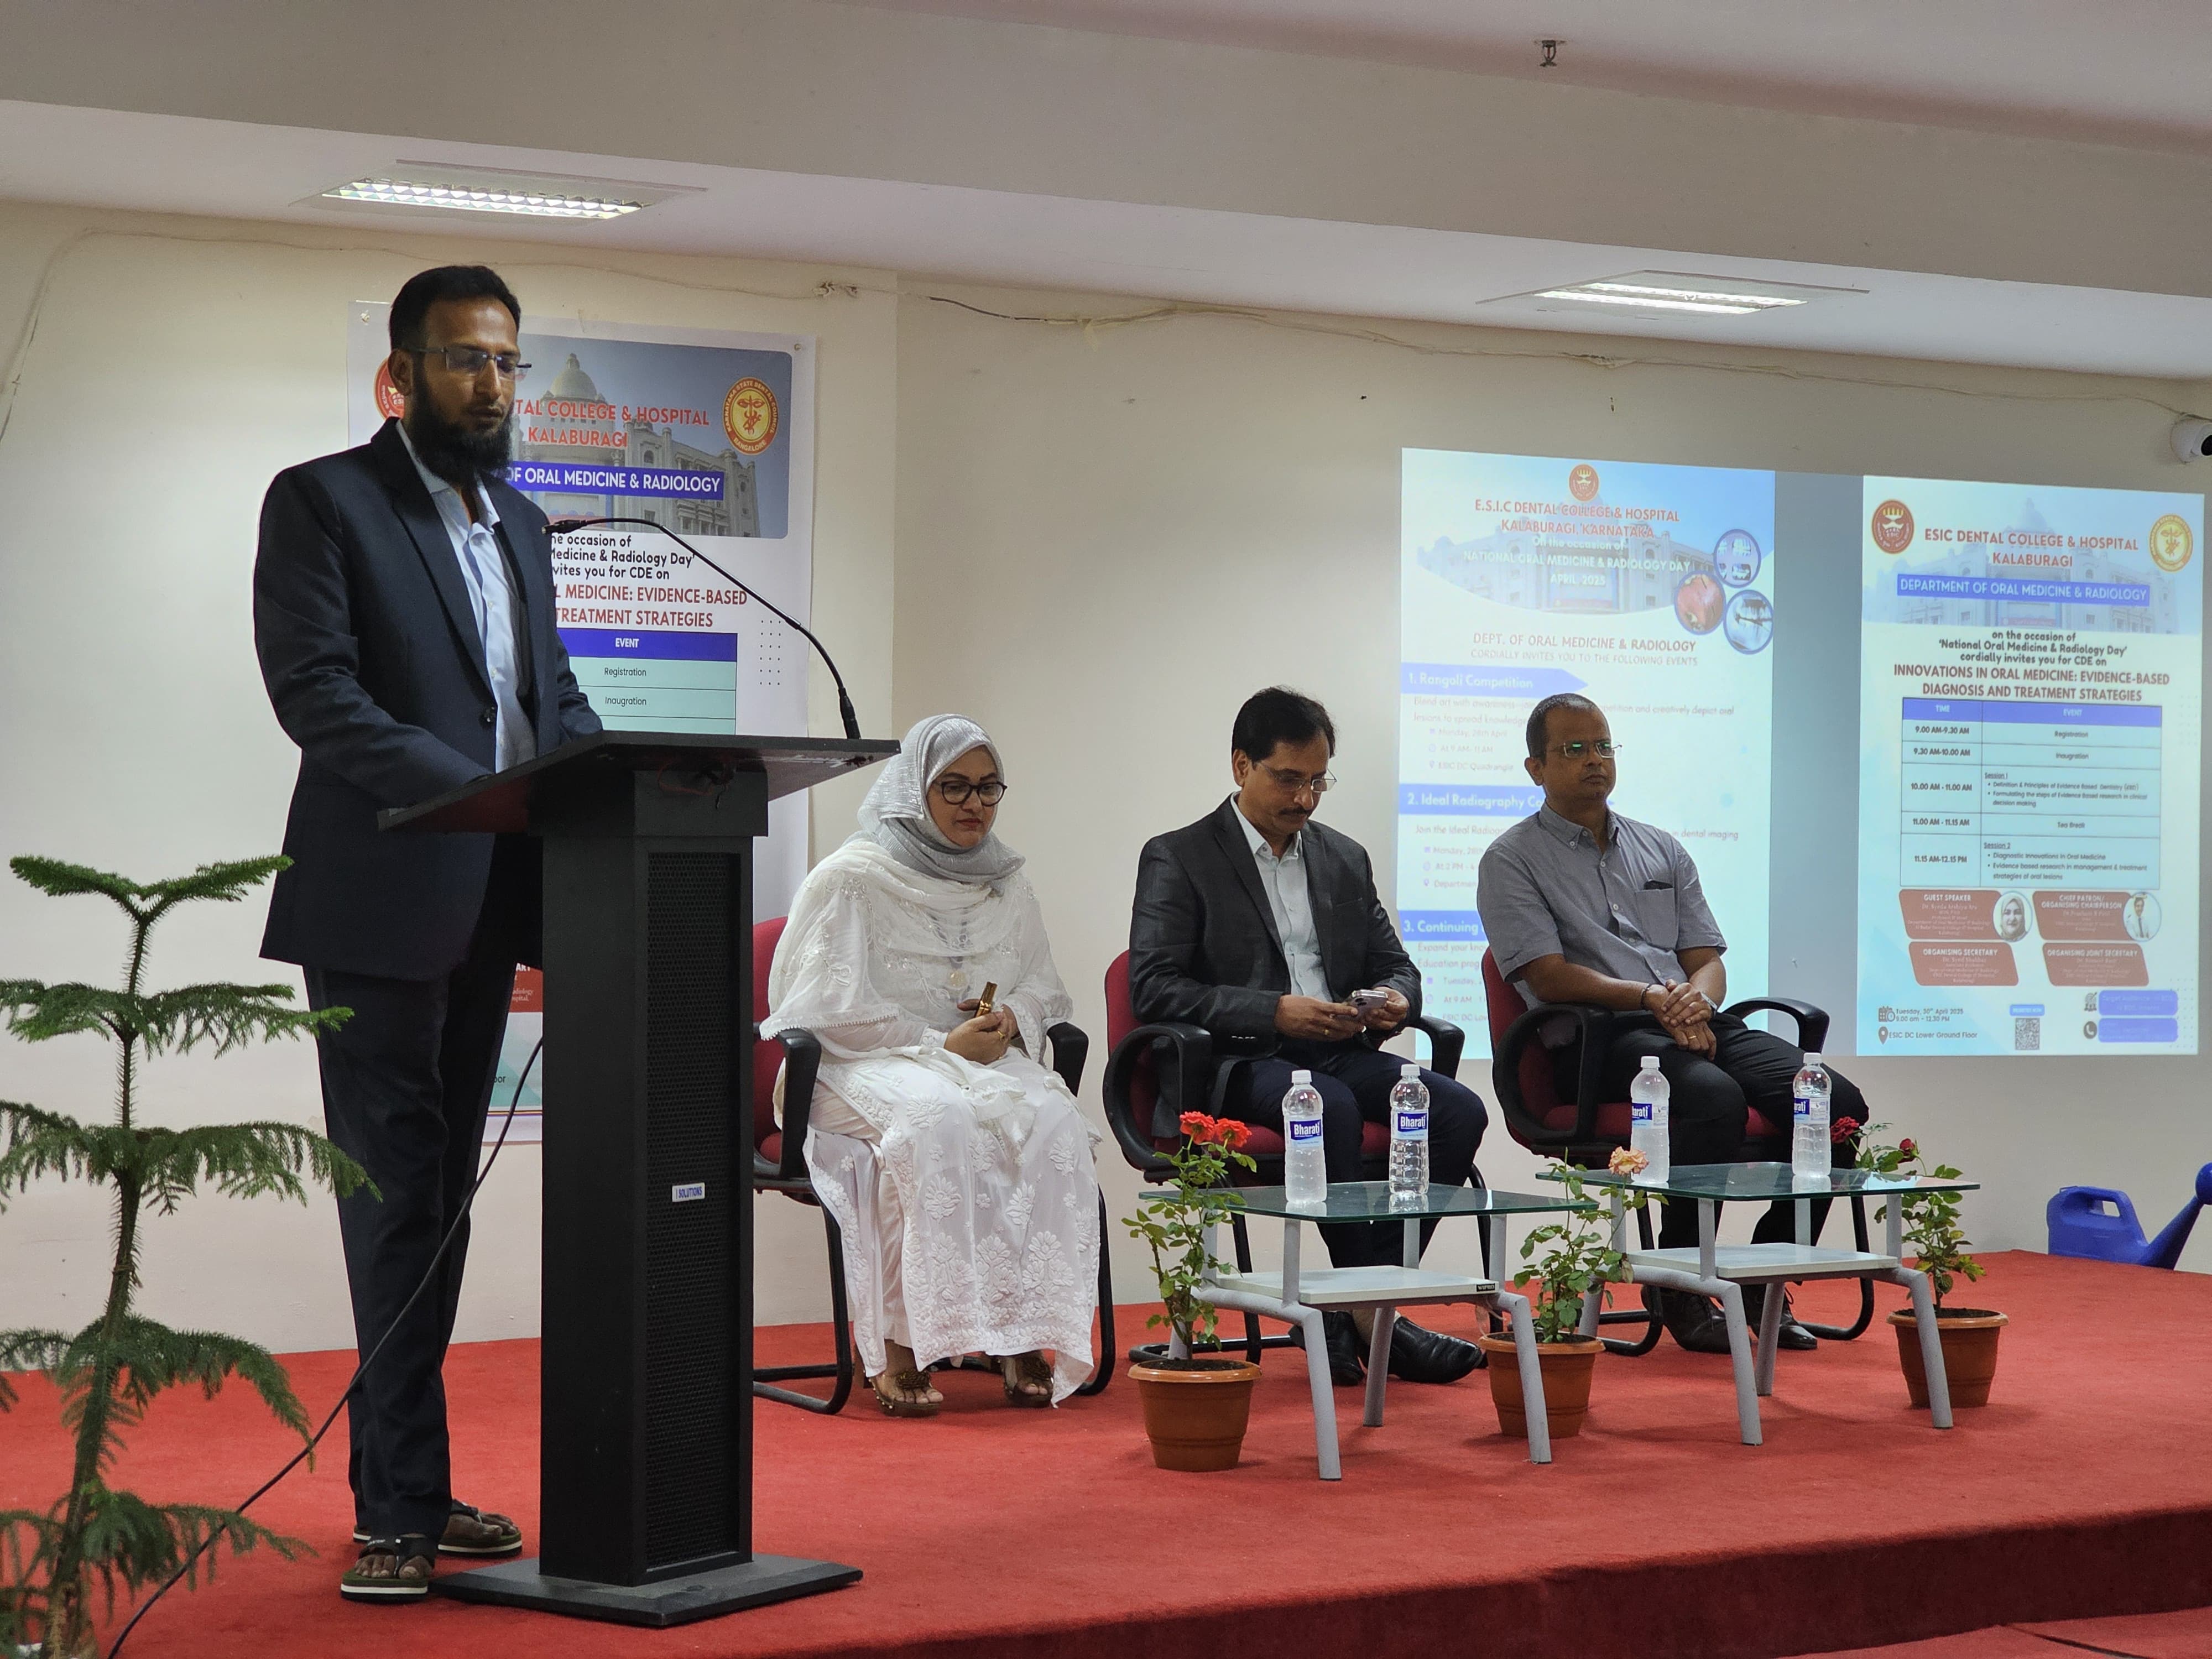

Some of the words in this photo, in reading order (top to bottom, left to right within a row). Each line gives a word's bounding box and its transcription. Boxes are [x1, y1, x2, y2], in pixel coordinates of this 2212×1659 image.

[737, 380, 753, 390] STATE
[754, 382, 773, 401] DENTAL
[516, 399, 542, 415] TAL
[547, 401, 616, 420] COLLEGE
[622, 405, 631, 421] &
[637, 406, 709, 426] HOSPITAL
[528, 426, 628, 447] KALABURAGI
[733, 437, 767, 452] BANGALORE
[525, 467, 561, 485] ORAL
[565, 469, 626, 488] MEDICINE
[629, 475, 639, 488] &
[643, 474, 719, 493] RADIOLOGY
[1475, 499, 1511, 513] E.S.I.C
[1514, 502, 1558, 515] DENTAL
[1561, 505, 1611, 518] COLLEGE
[1614, 507, 1622, 518] &
[1625, 508, 1680, 522] HOSPITAL
[1582, 523, 1655, 539] KARNATAKA
[1924, 528, 1953, 541] ESIC
[1957, 530, 2004, 544] DENTAL
[2008, 533, 2064, 546] COLLEGE
[2067, 536, 2075, 547] &
[2080, 536, 2138, 550] HOSPITAL
[567, 534, 615, 547] occasion
[619, 535, 632, 547] of
[599, 550, 608, 562] &
[611, 551, 667, 567] Radiology
[1464, 551, 1515, 564] NATIONAL
[1518, 553, 1544, 565] ORAL
[1547, 555, 1595, 567] MEDICINE
[1597, 557, 1604, 567] &
[1606, 557, 1667, 570] RADIOLOGY
[1669, 560, 1691, 572] DAY
[1992, 552, 2073, 567] KALABURAGI
[552, 564, 581, 576] vites
[585, 567, 605, 580] you
[609, 565, 626, 578] for
[629, 567, 653, 579] CDE
[656, 570, 670, 580] on
[1582, 574, 1605, 586] 2025
[565, 584, 633, 601] MEDICINE:
[637, 587, 747, 606] EVIDENCE-BASED
[1900, 579, 1970, 594] DEPARTMENT
[1973, 581, 1987, 594] OF
[1990, 582, 2018, 596] ORAL
[2022, 584, 2071, 598] MEDICINE
[2074, 587, 2082, 598] &
[2085, 586, 2148, 601] RADIOLOGY
[636, 611, 713, 628] STRATEGIES
[615, 638, 639, 648] EVENT
[1473, 632, 1505, 645] DEPT.
[1509, 634, 1524, 645] OF
[1528, 635, 1558, 646] ORAL
[1562, 637, 1615, 649] MEDICINE
[1619, 639, 1627, 649] &
[1631, 639, 1696, 652] RADIOLOGY
[1991, 631, 2004, 640] on
[2006, 630, 2022, 640] the
[2025, 632, 2064, 641] occasion
[2067, 632, 2076, 641] of
[1984, 640, 2004, 651] Oral
[2007, 641, 2047, 653] Medicine
[2050, 643, 2057, 653] &
[2059, 643, 2104, 656] Radiology
[1960, 653, 2001, 664] cordially
[2004, 654, 2036, 664] invites
[2038, 656, 2056, 666] you
[2058, 655, 2072, 665] for
[2074, 656, 2093, 666] CDE
[2095, 658, 2107, 666] on
[604, 667, 646, 678] Registration
[1409, 672, 1417, 685] 1.
[1420, 672, 1463, 688] Rangoli
[1465, 674, 1533, 689] Competition
[1893, 664, 1973, 678] INNOVATIONS
[1976, 666, 1987, 679] IN
[1990, 667, 2021, 680] ORAL
[2023, 668, 2077, 682] MEDICINE:
[2080, 671, 2170, 685] EVIDENCE-BASED
[1922, 682, 1984, 696] DIAGNOSIS
[1987, 685, 2012, 697] AND
[2014, 685, 2077, 699] TREATMENT
[2079, 688, 2142, 702] STRATEGIES
[604, 696, 647, 707] Inaugration
[1936, 705, 1950, 713] TIME
[2063, 708, 2083, 717] EVENT
[2054, 731, 2089, 739] Registration
[1407, 792, 1419, 806] 2.
[1421, 793, 1449, 806] Ideal
[1452, 794, 1526, 810] Radiography
[1404, 920, 1415, 932] 3.
[1417, 920, 1479, 936] Continuing
[1632, 1105, 1648, 1118] arati
[1294, 1122, 1320, 1135] Bharati
[1400, 1115, 1426, 1128] Bharati
[678, 1186, 702, 1198] SOLUTIONS
